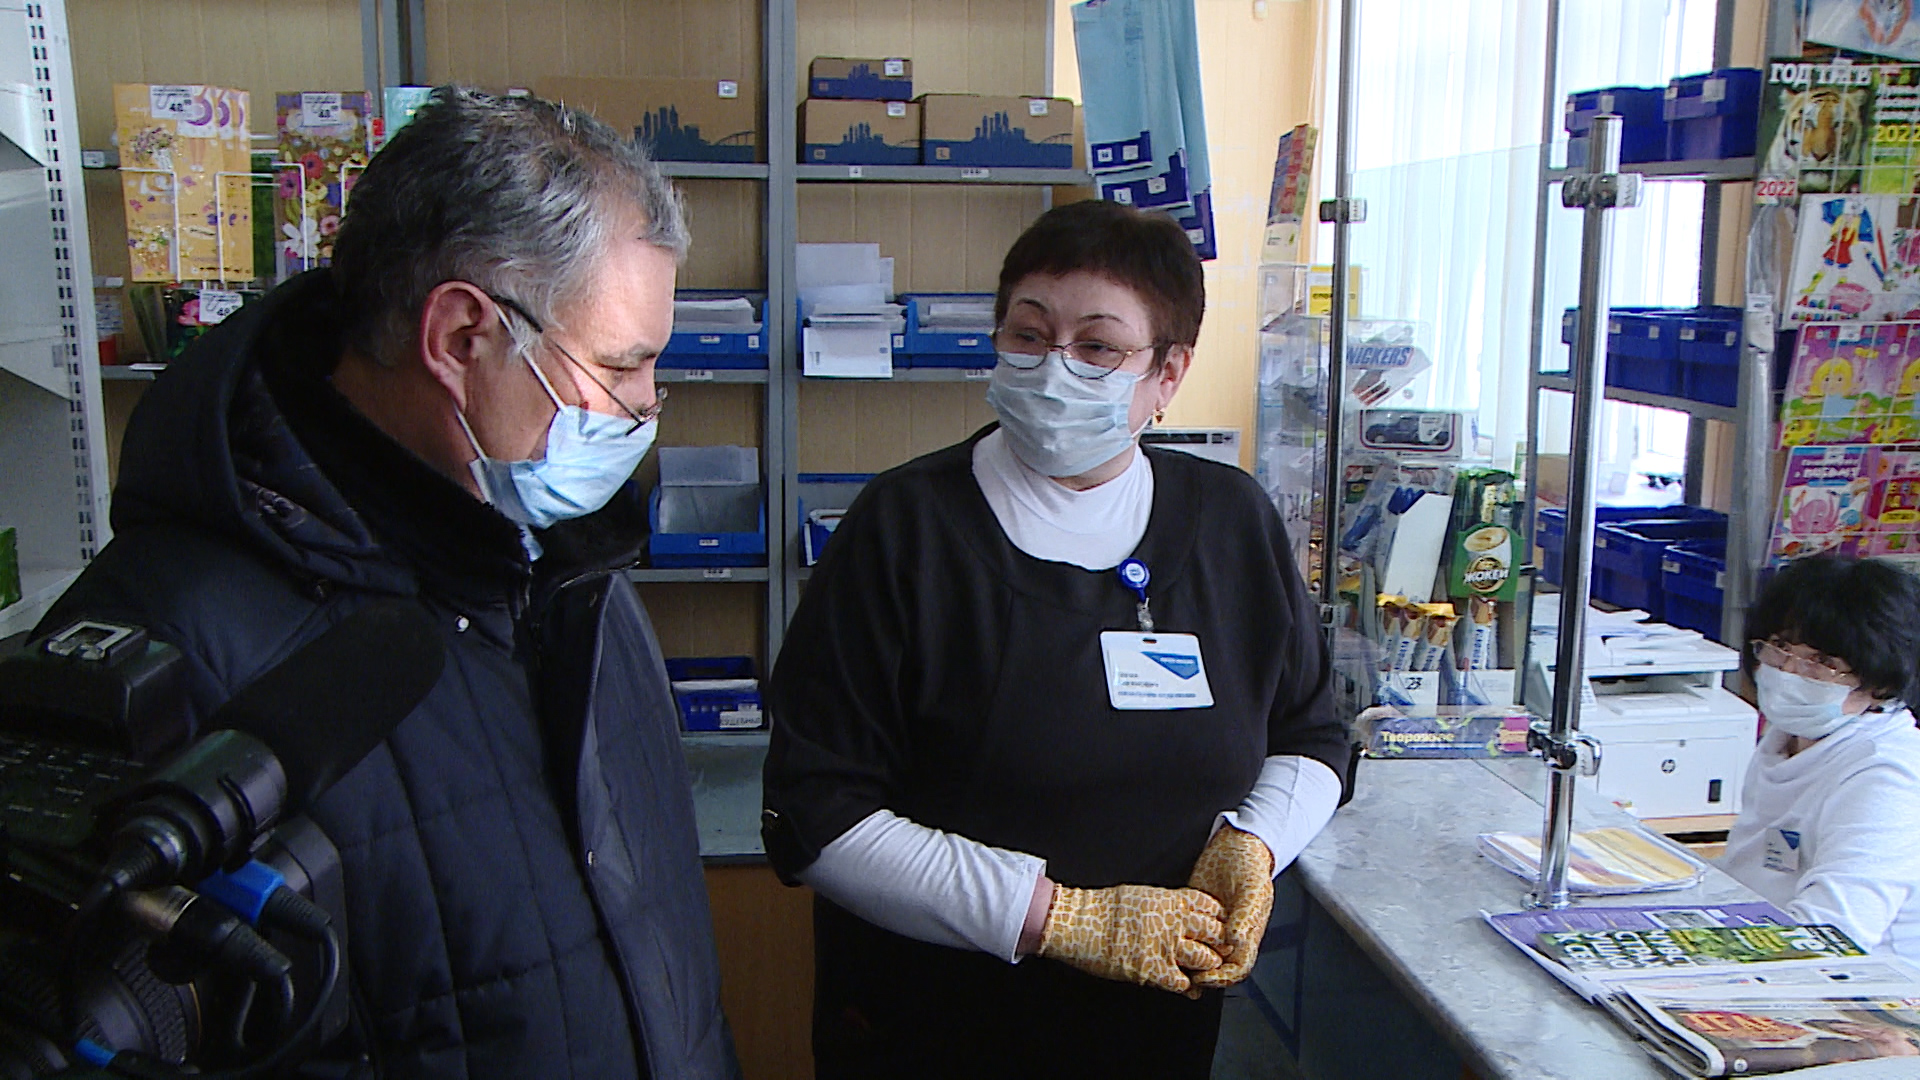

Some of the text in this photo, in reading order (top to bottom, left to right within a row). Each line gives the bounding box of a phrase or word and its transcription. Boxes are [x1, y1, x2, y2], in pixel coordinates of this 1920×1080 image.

[1768, 63, 1812, 88] ГОД
[1873, 124, 1920, 142] 2022
[1757, 181, 1795, 196] 2022
[1347, 346, 1411, 367] NICKERS
